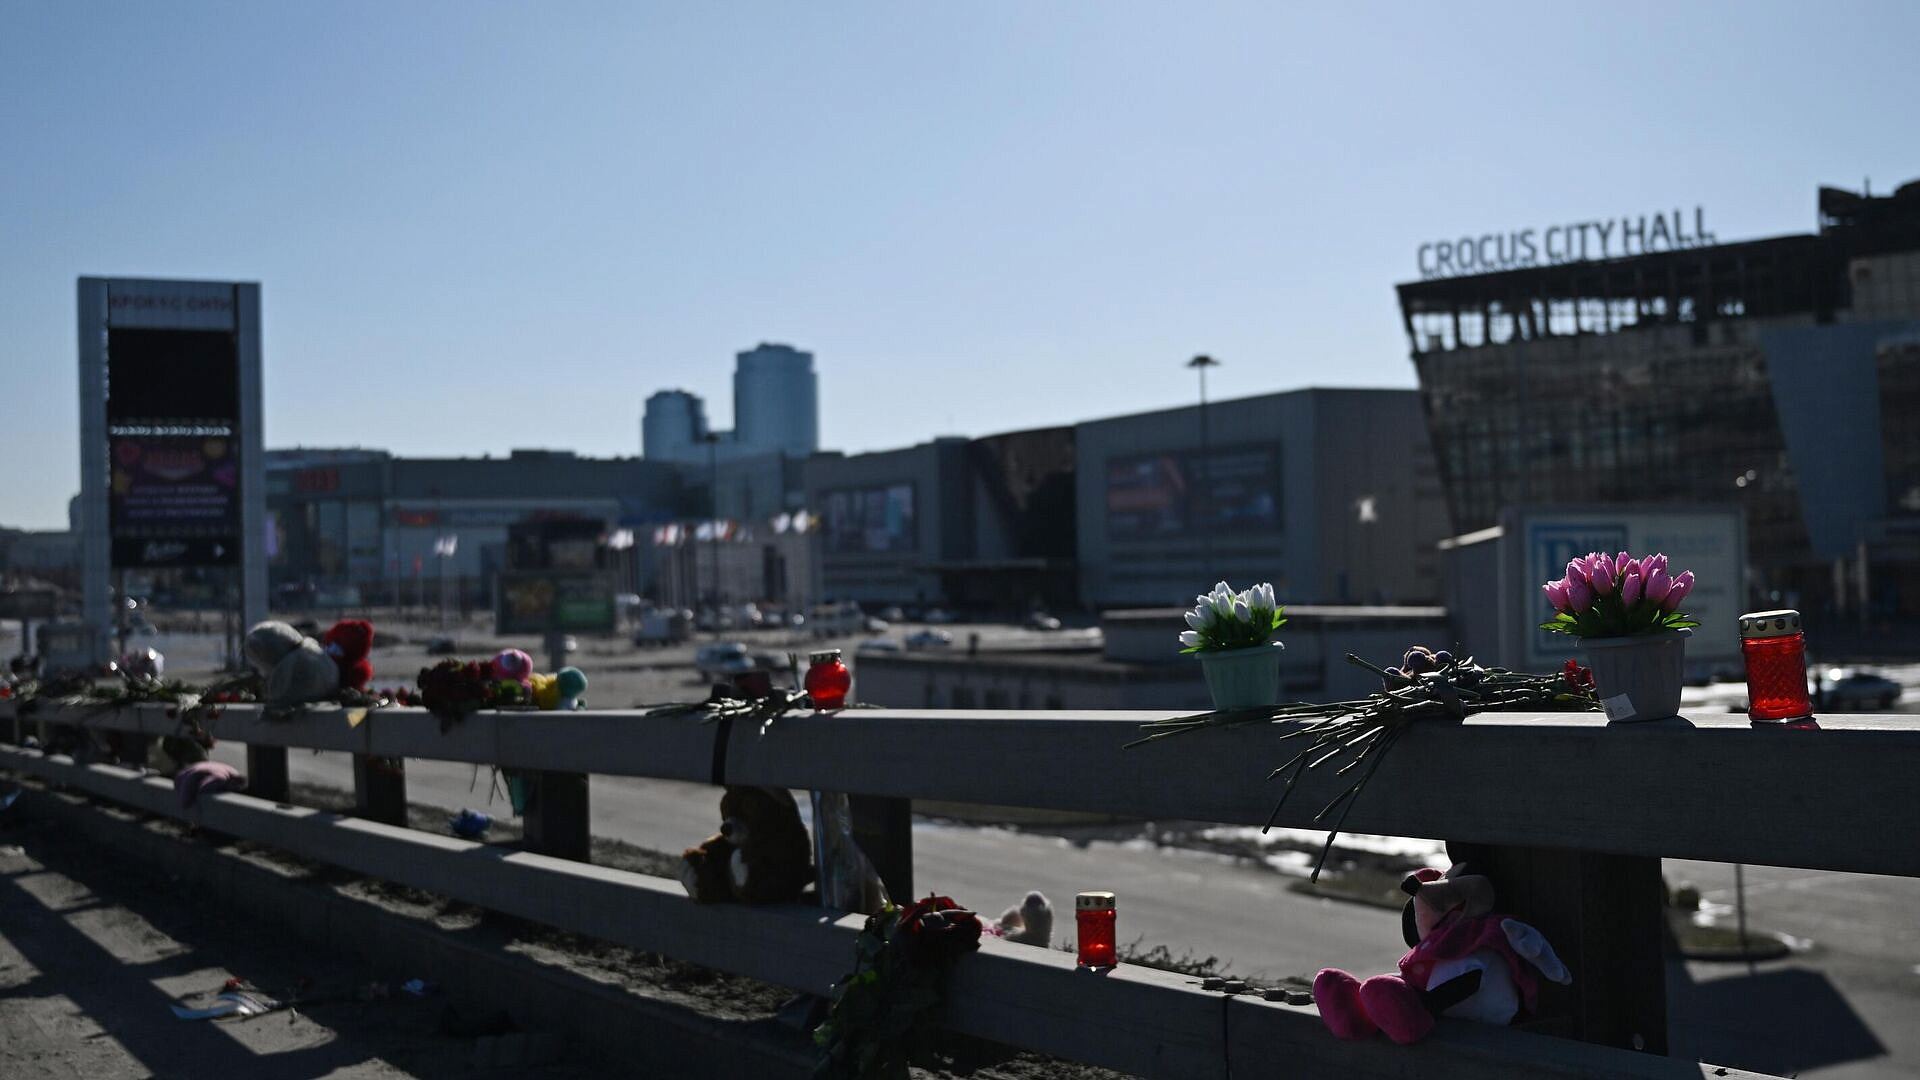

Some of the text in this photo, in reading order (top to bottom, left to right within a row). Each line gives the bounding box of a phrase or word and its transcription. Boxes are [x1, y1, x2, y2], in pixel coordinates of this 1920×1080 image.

[1417, 205, 1715, 276] CROCUS CITY HALL
